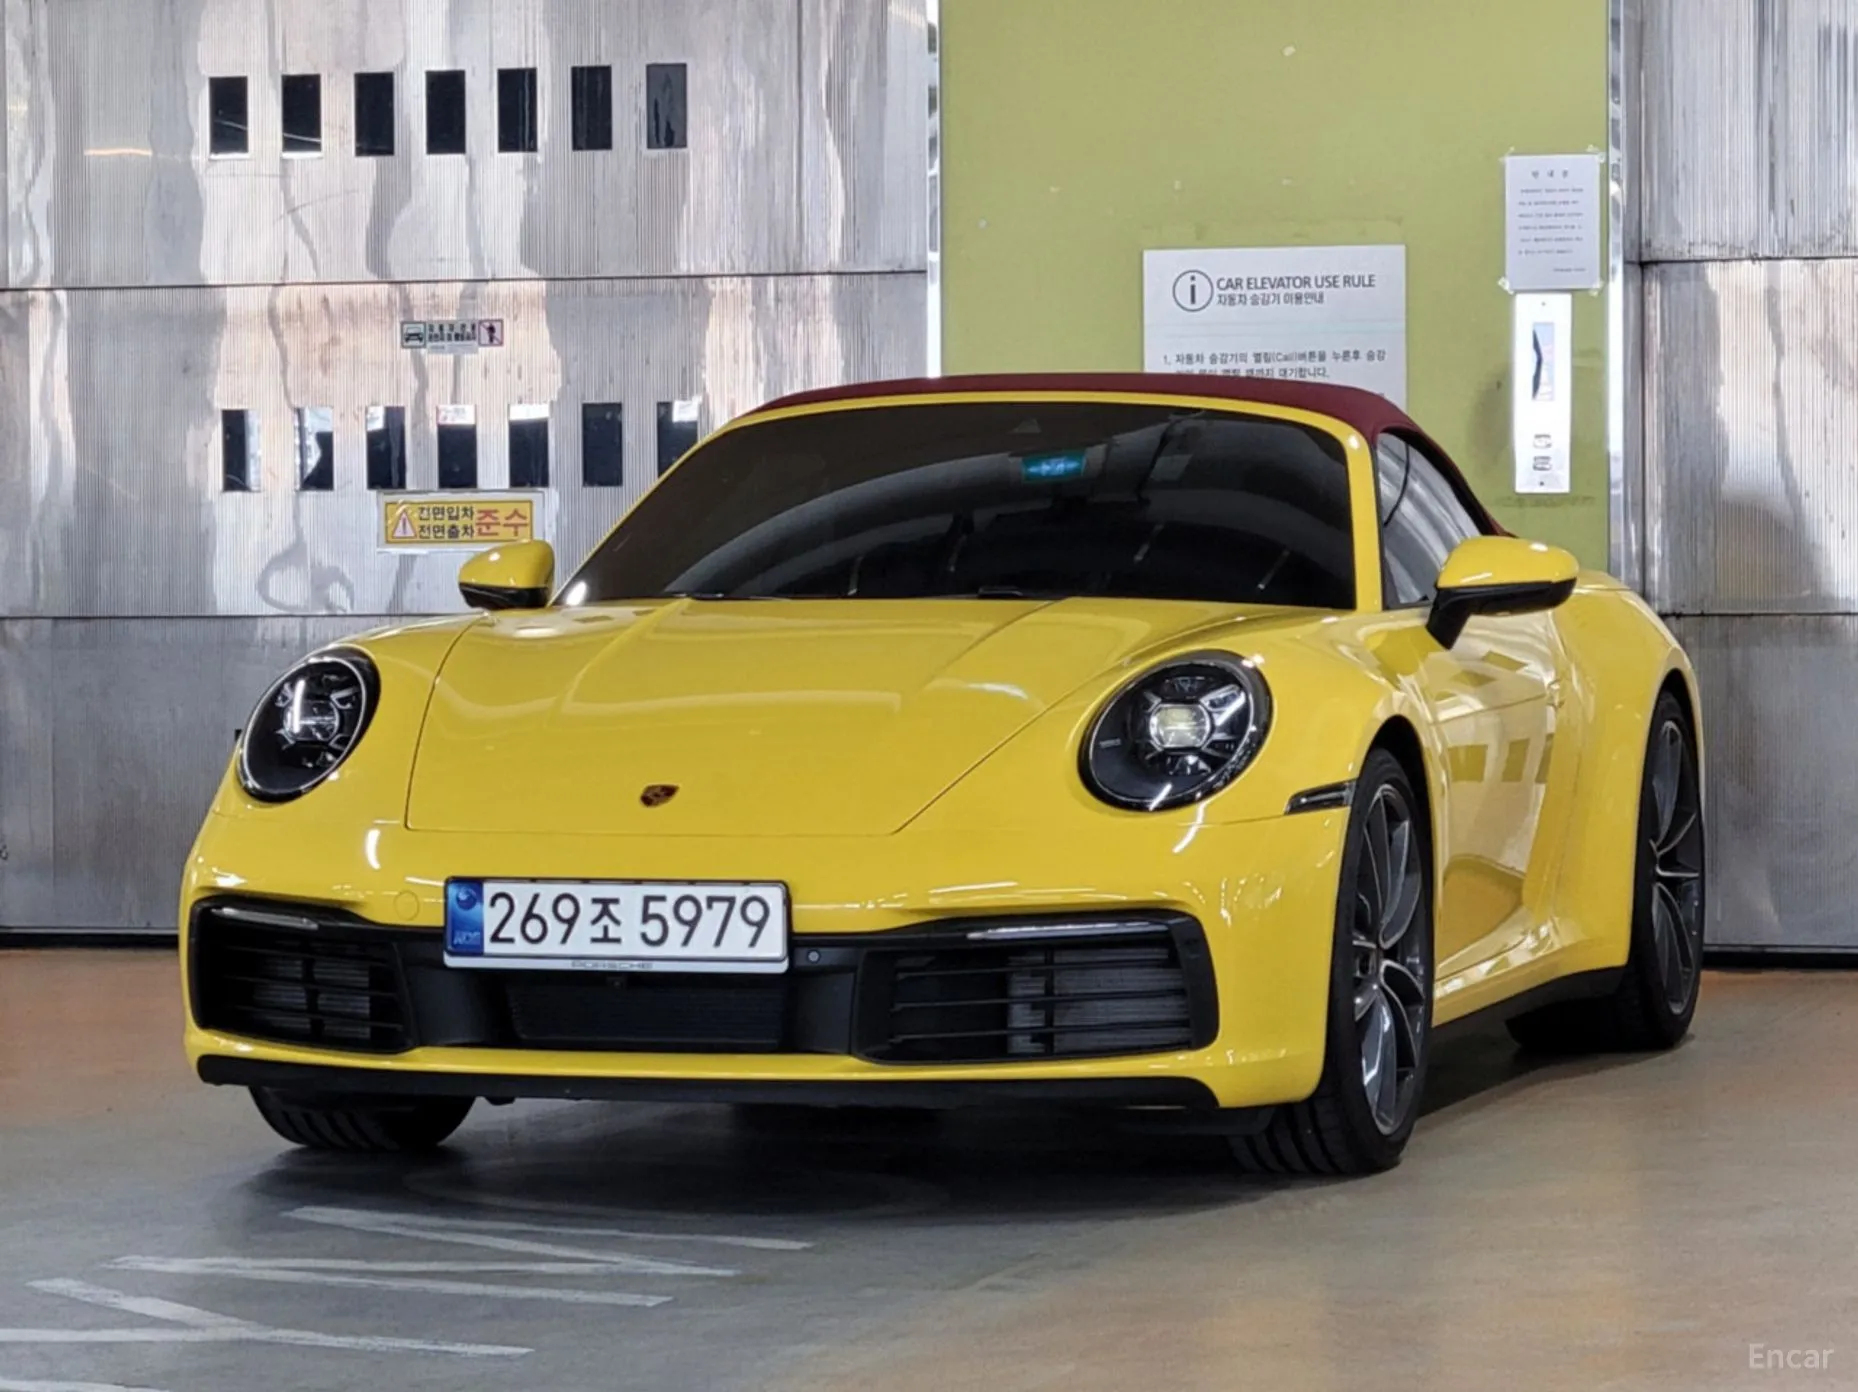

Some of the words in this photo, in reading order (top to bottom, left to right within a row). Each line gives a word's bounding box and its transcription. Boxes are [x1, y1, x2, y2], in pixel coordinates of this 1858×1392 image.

[1217, 277, 1243, 291] CAR
[1246, 275, 1311, 290] ELEVATOR
[1315, 275, 1339, 289] USE
[1343, 274, 1375, 288] RULE
[1217, 293, 1247, 306] 자동차
[1283, 291, 1325, 305] 이용안내
[1175, 353, 1204, 365] 자동차
[475, 508, 528, 536] 준수
[489, 892, 622, 945] 269조
[639, 894, 770, 948] 5979
